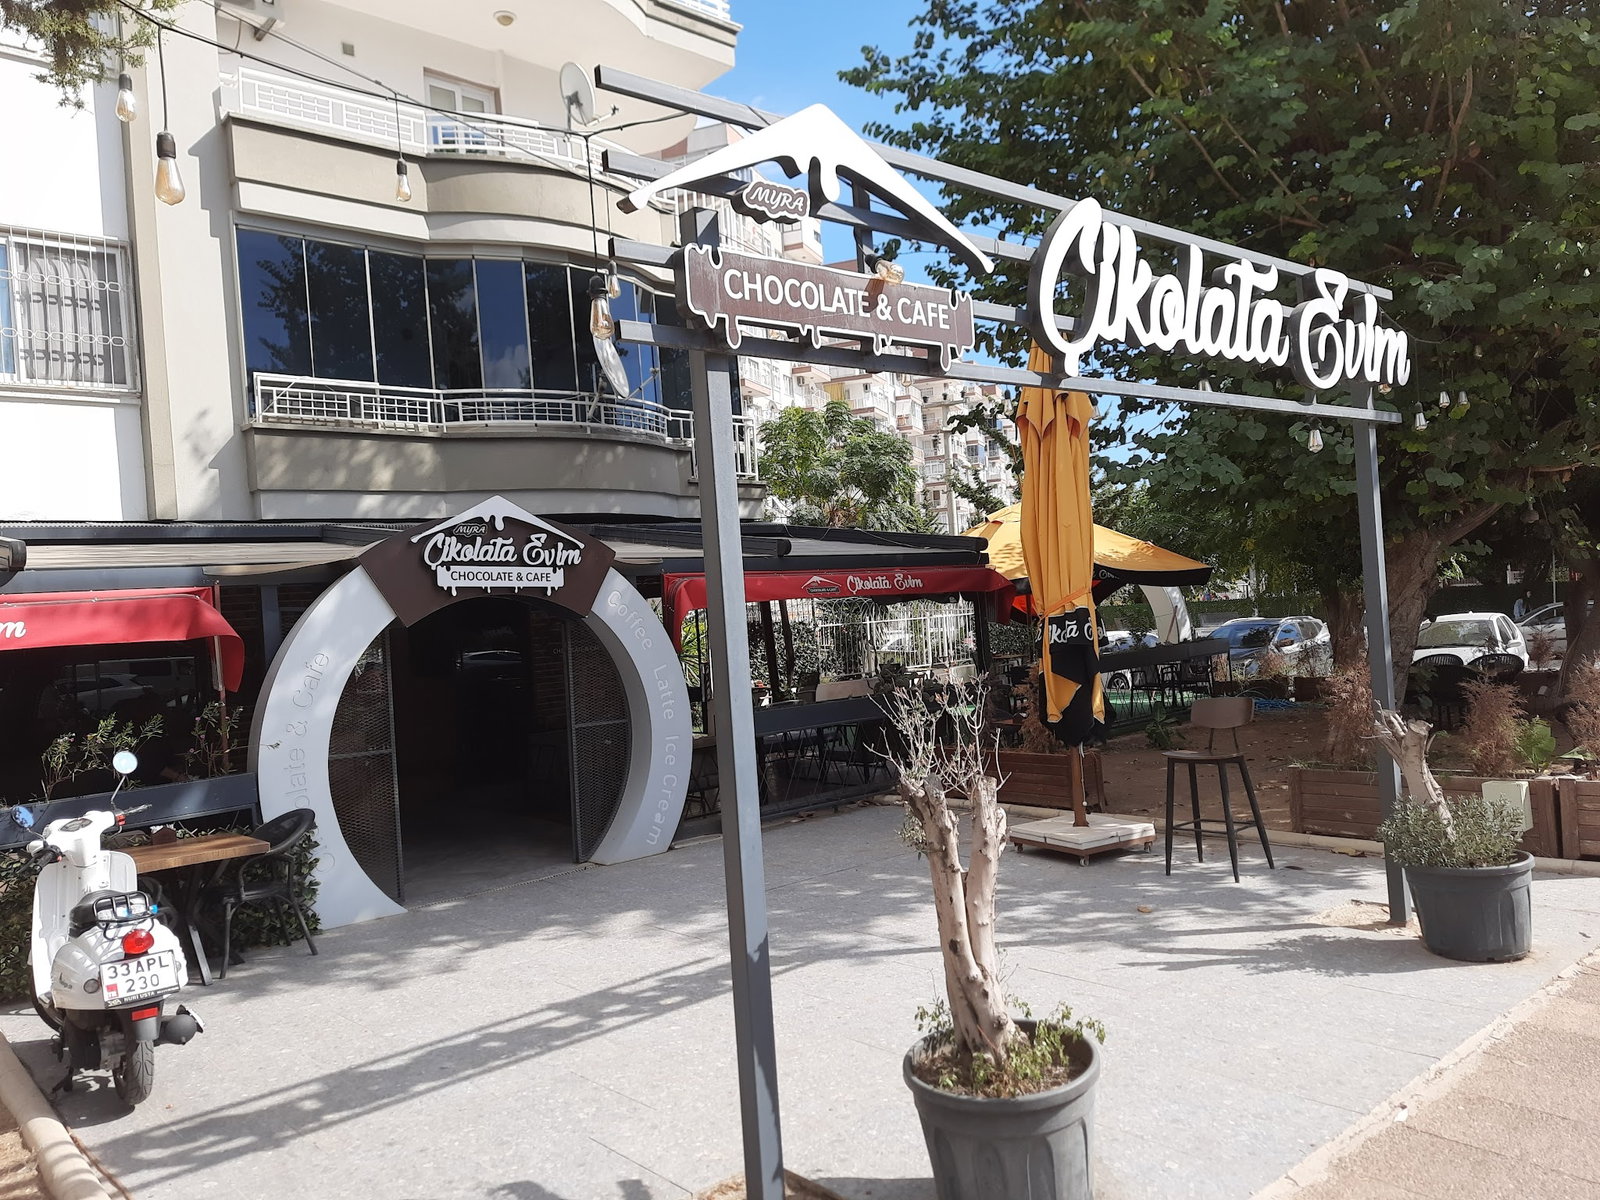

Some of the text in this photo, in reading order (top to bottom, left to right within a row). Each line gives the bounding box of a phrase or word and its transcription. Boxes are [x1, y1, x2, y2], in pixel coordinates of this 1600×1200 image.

[749, 184, 805, 211] MYRA
[723, 269, 951, 330] CHOCOLATE & CAFE
[455, 527, 487, 536] MYRA
[450, 571, 552, 583] CHOCOLATE & CAFE
[607, 590, 680, 845] Coffee Latte Ice Cream
[285, 720, 308, 737] &
[107, 956, 169, 979] 33 APL
[125, 974, 160, 993] 230
